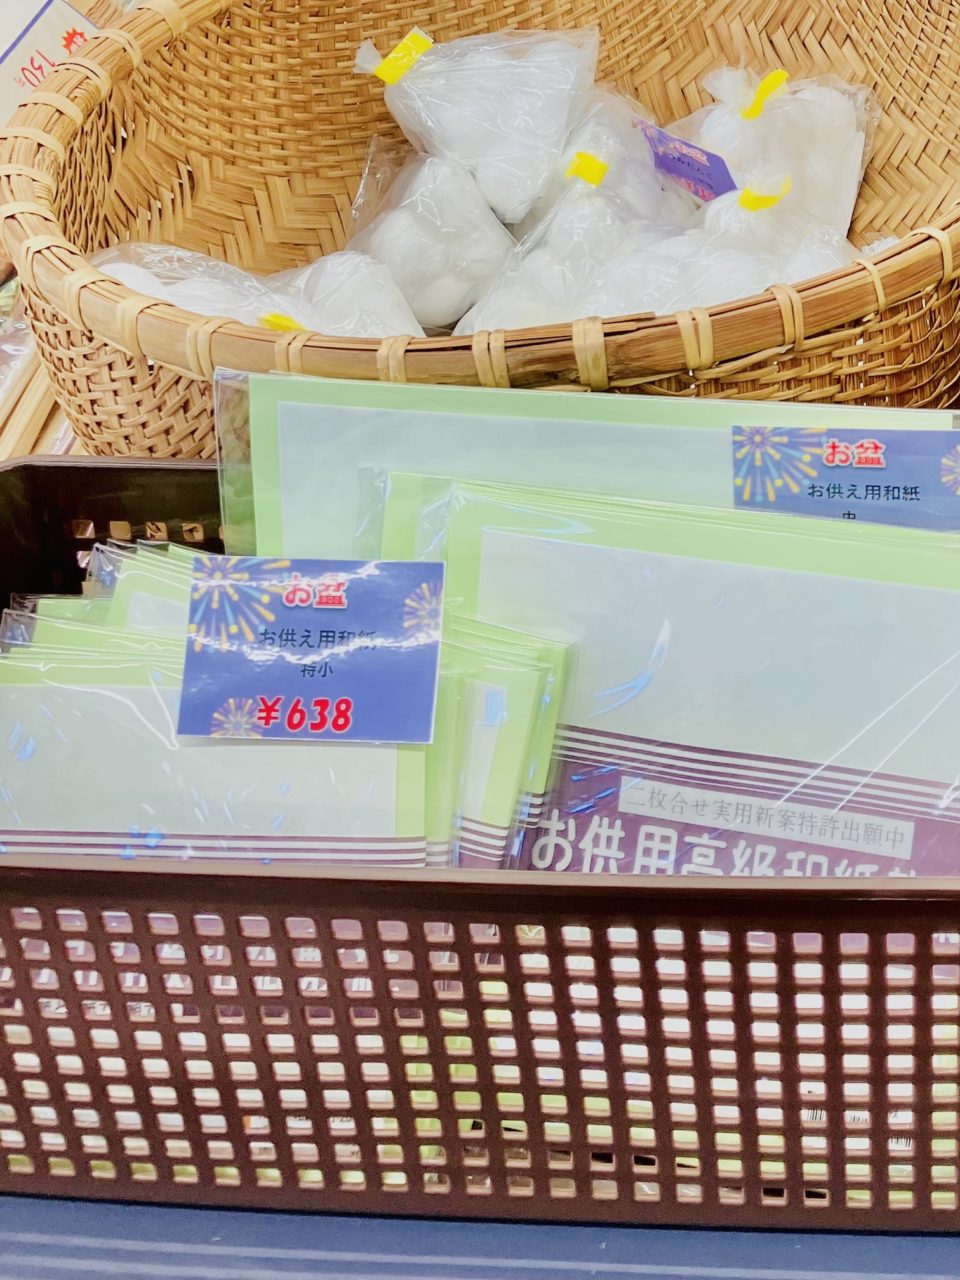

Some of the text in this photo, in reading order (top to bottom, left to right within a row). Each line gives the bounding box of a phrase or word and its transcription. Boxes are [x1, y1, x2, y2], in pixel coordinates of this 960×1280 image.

[823, 438, 887, 469] お盆
[808, 483, 921, 502] お供え用和紙
[283, 572, 349, 609] お盆
[259, 627, 378, 651] お供え用和紙
[256, 695, 353, 734] ¥638
